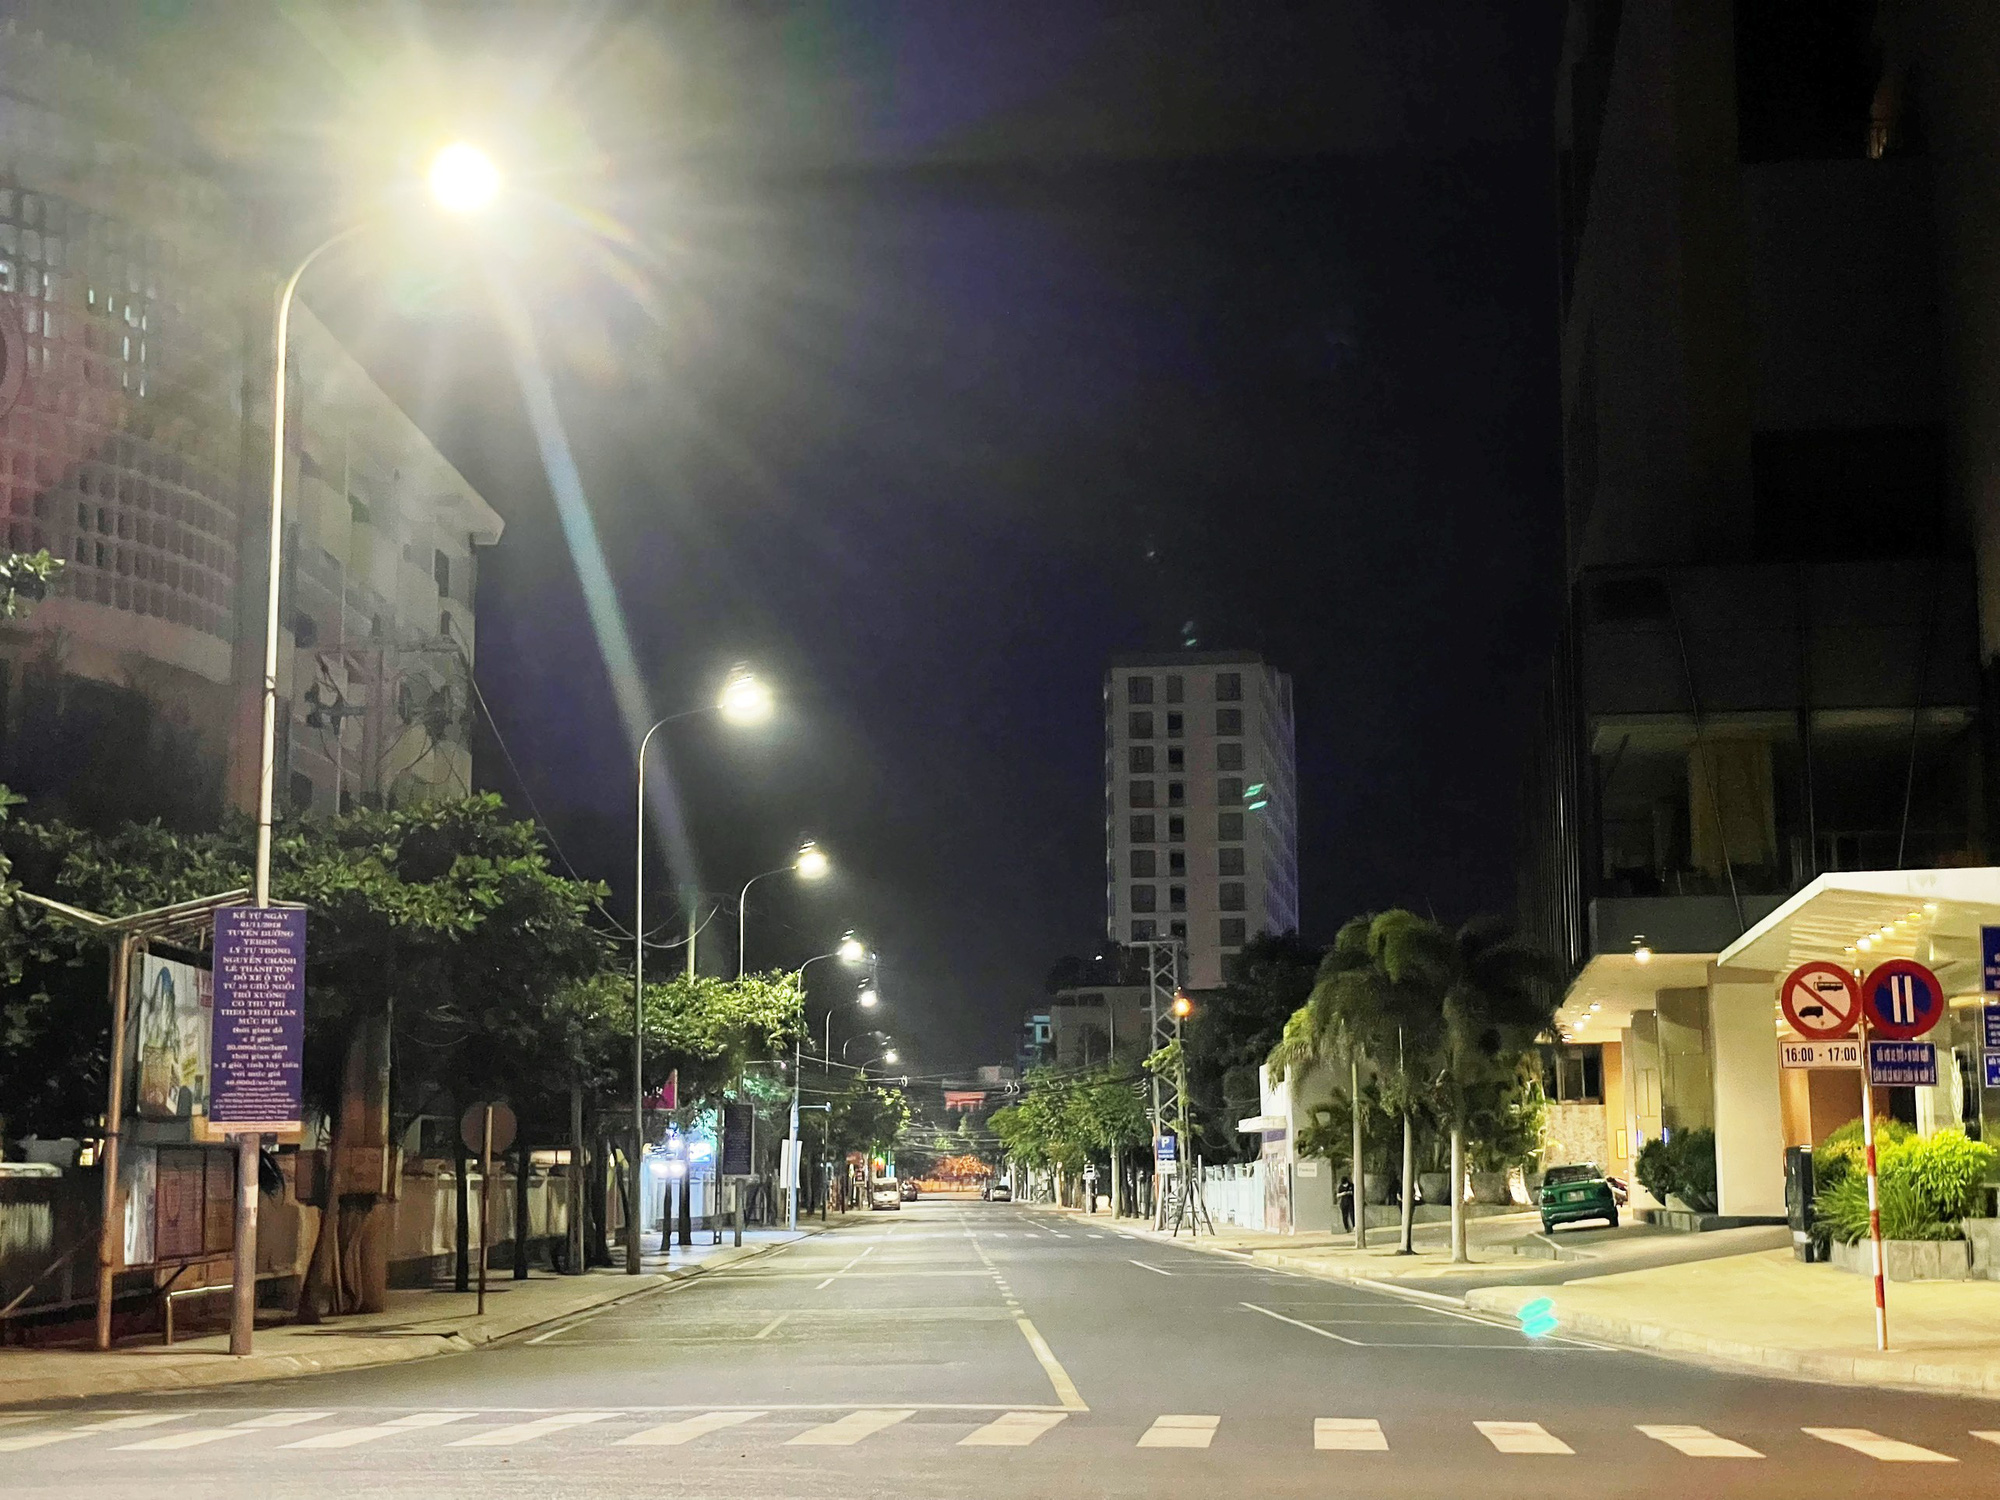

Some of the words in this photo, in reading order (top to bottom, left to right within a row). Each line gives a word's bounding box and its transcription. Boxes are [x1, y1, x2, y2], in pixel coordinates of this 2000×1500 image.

[1785, 1048, 1813, 1062] 16:00
[1828, 1047, 1856, 1061] 17:00
[1162, 1138, 1169, 1148] P
